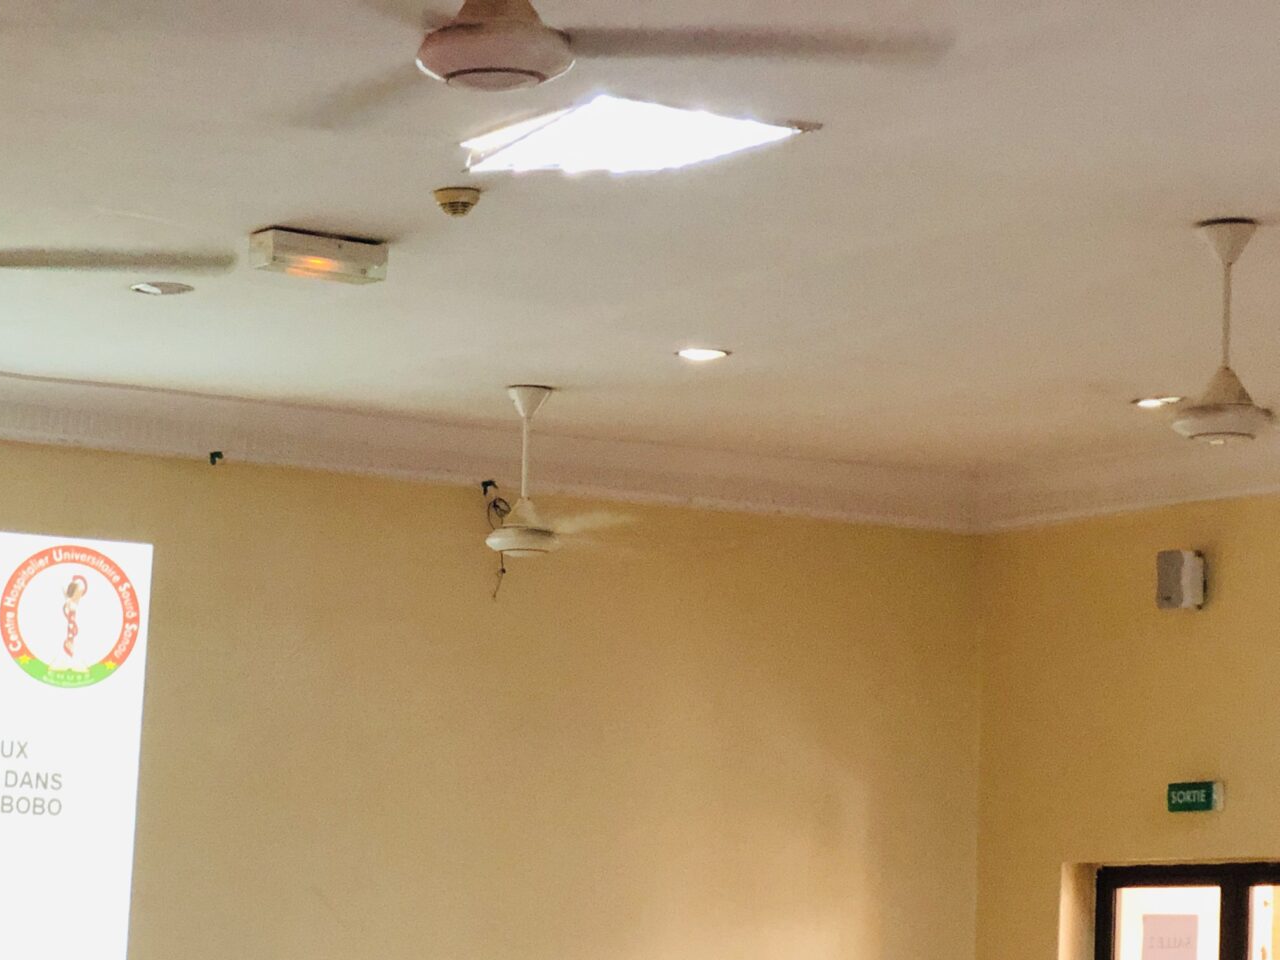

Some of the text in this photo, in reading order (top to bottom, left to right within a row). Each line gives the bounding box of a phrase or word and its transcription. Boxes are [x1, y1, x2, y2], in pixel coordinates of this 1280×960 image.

[3, 555, 49, 608] Hospitalier
[52, 549, 120, 583] Universitaire
[6, 611, 22, 652] Centre
[113, 623, 138, 658] Sanou
[4, 769, 63, 791] DANS
[1170, 790, 1207, 804] SORTIE
[0, 795, 63, 817] BOBO
